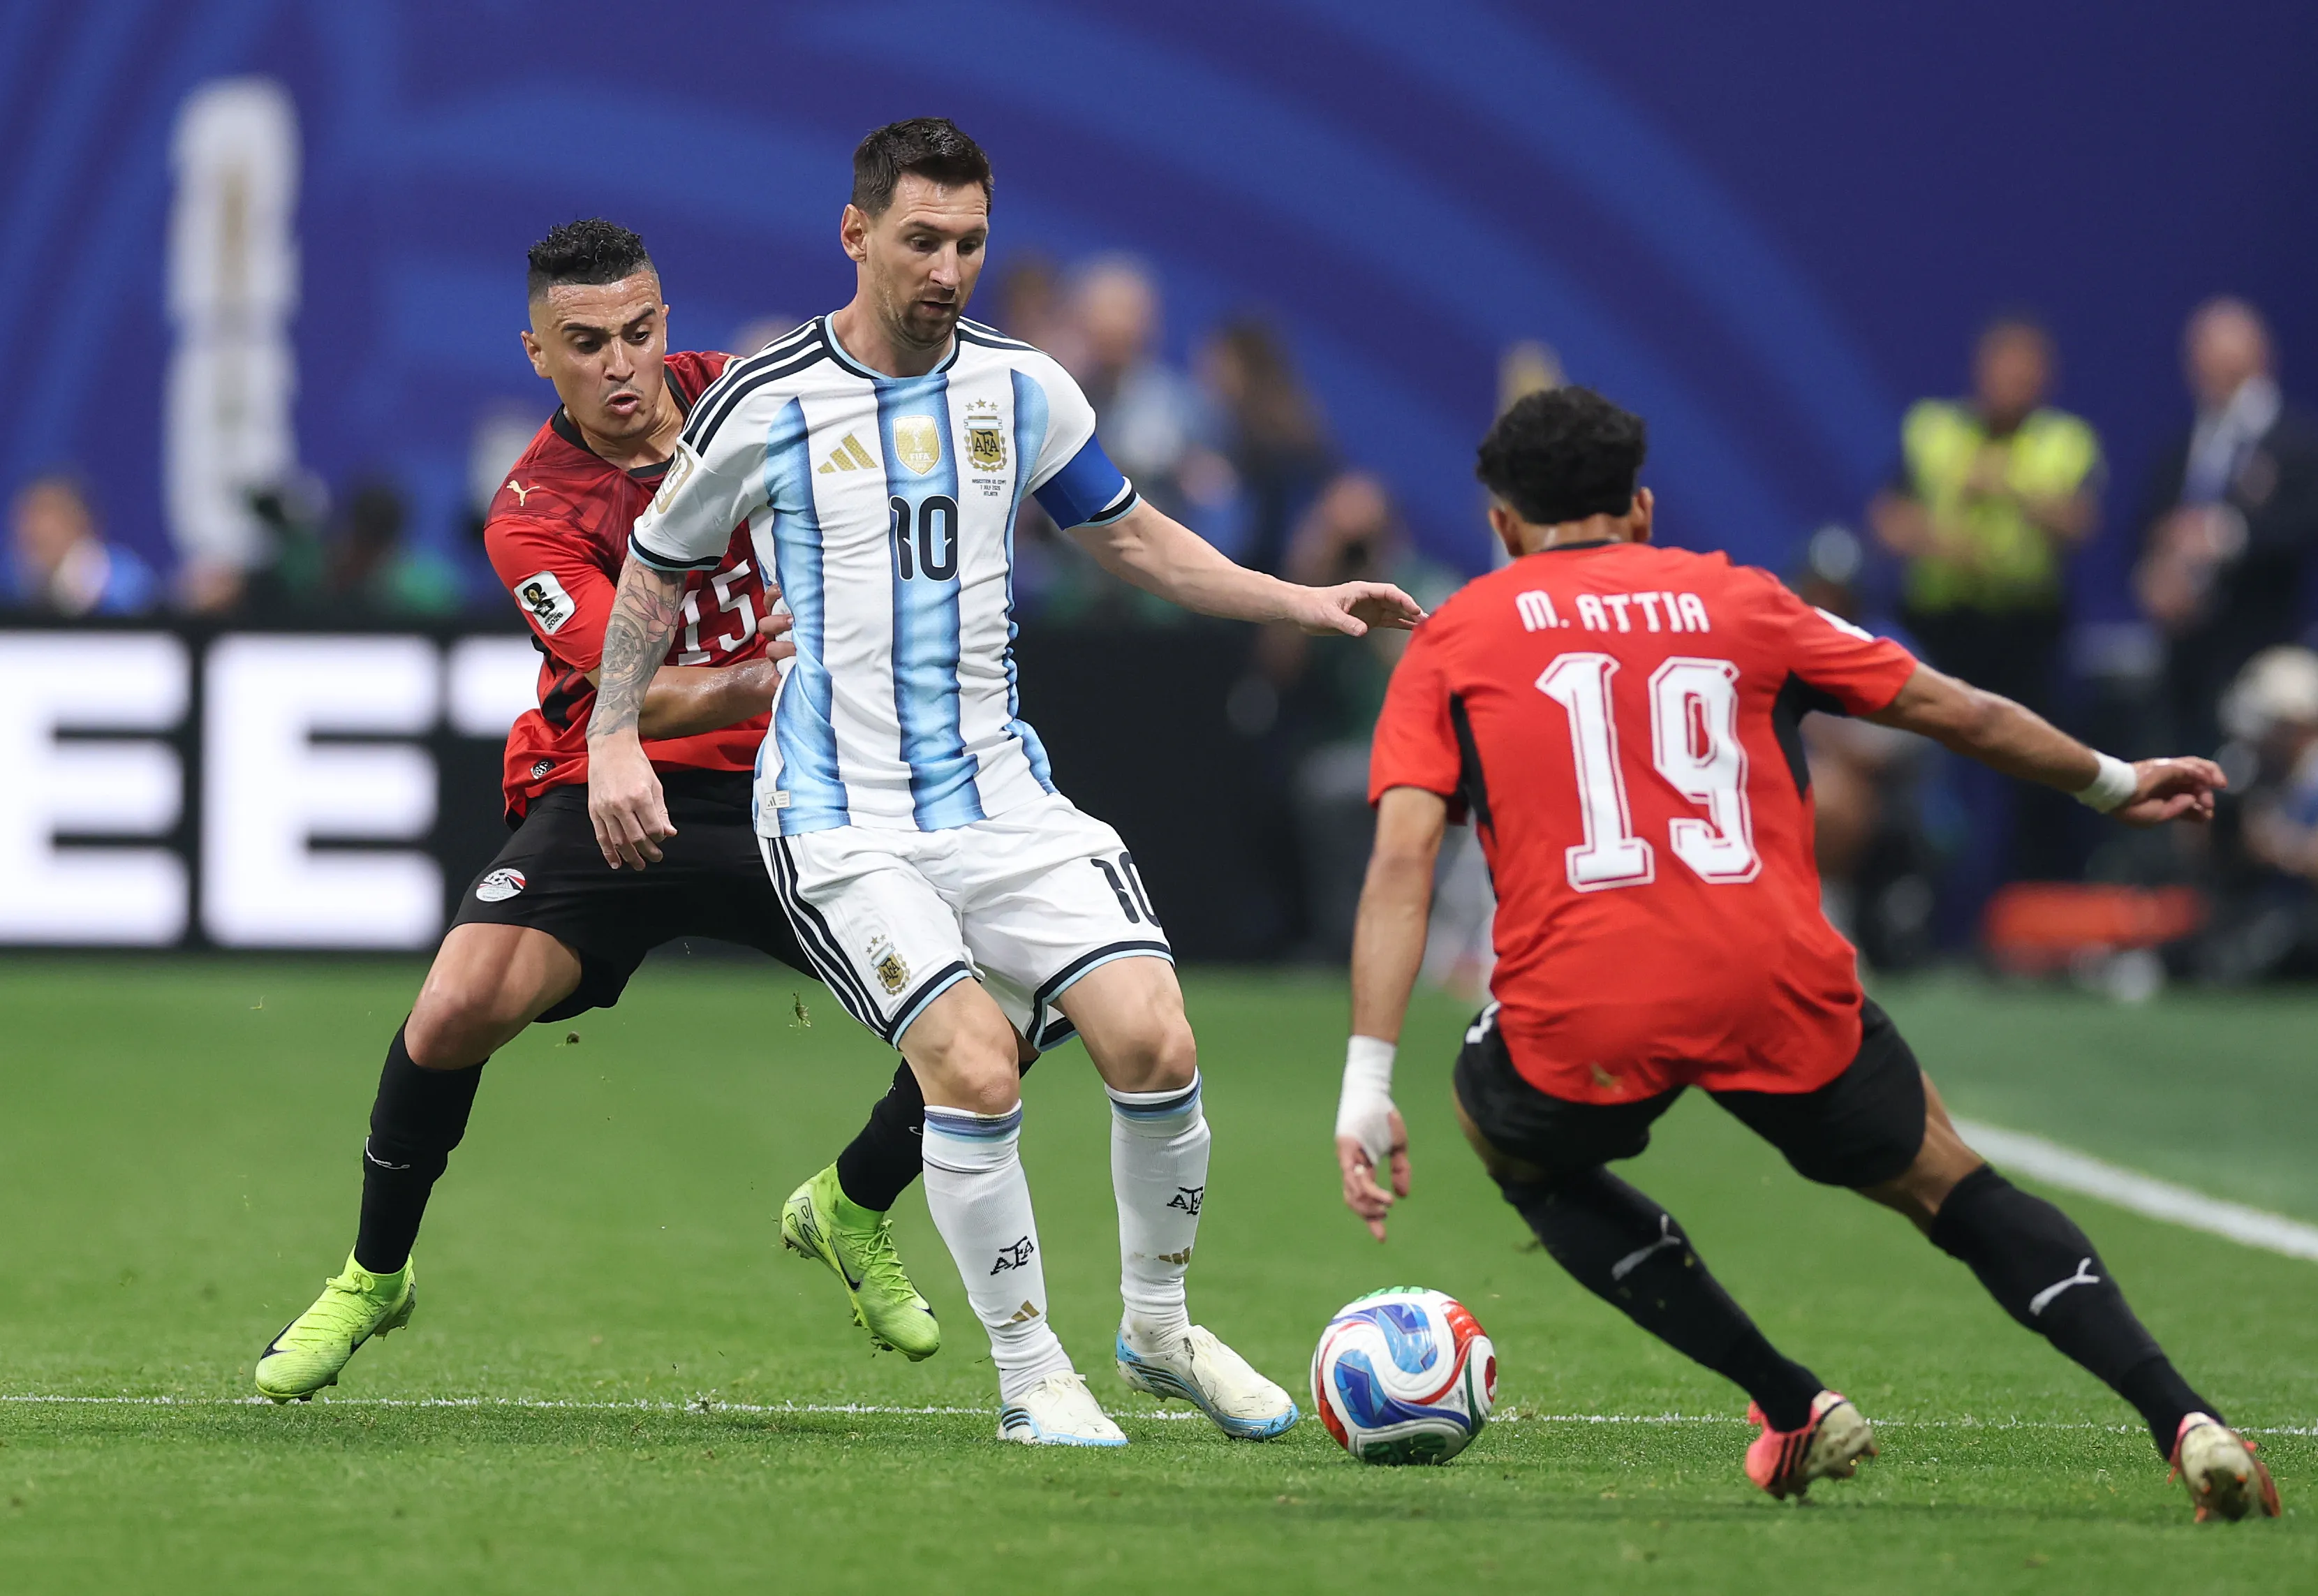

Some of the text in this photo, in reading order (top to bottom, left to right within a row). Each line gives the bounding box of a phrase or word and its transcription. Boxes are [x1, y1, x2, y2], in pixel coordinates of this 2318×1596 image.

[910, 452, 930, 461] FIFA
[975, 430, 998, 457] AFA
[889, 495, 958, 581] 10
[547, 612, 563, 630] 2026
[679, 559, 756, 666] 15
[1515, 590, 1710, 633] M. ATTIA
[1535, 651, 1762, 893] 19
[1091, 852, 1161, 928] 10
[990, 1235, 1034, 1276] AFA
